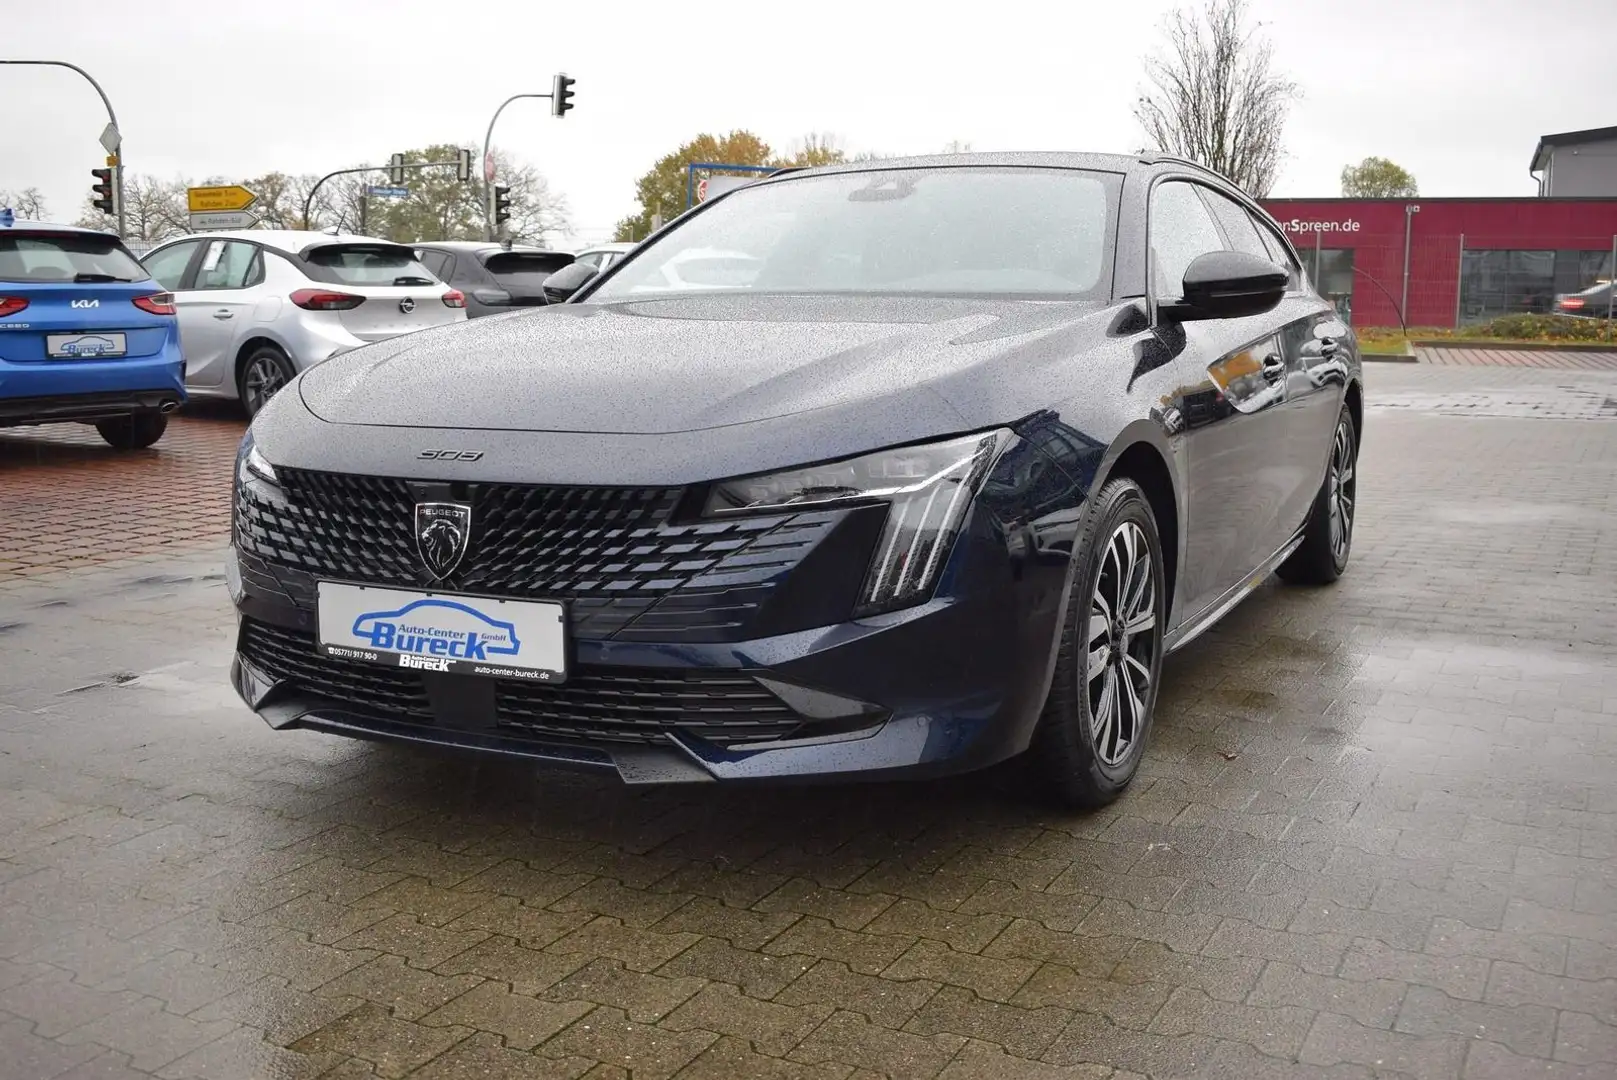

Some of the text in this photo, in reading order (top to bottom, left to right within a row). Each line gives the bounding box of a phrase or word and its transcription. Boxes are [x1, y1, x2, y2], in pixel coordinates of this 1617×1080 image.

[71, 299, 100, 309] KIA
[417, 449, 484, 462] 508
[420, 508, 466, 518] PEUGEOT
[398, 623, 507, 642] Auto-Center GmbH
[371, 621, 488, 661] Bureck
[398, 653, 450, 672] Bureck
[474, 666, 550, 680] auto-center-bureck.de
